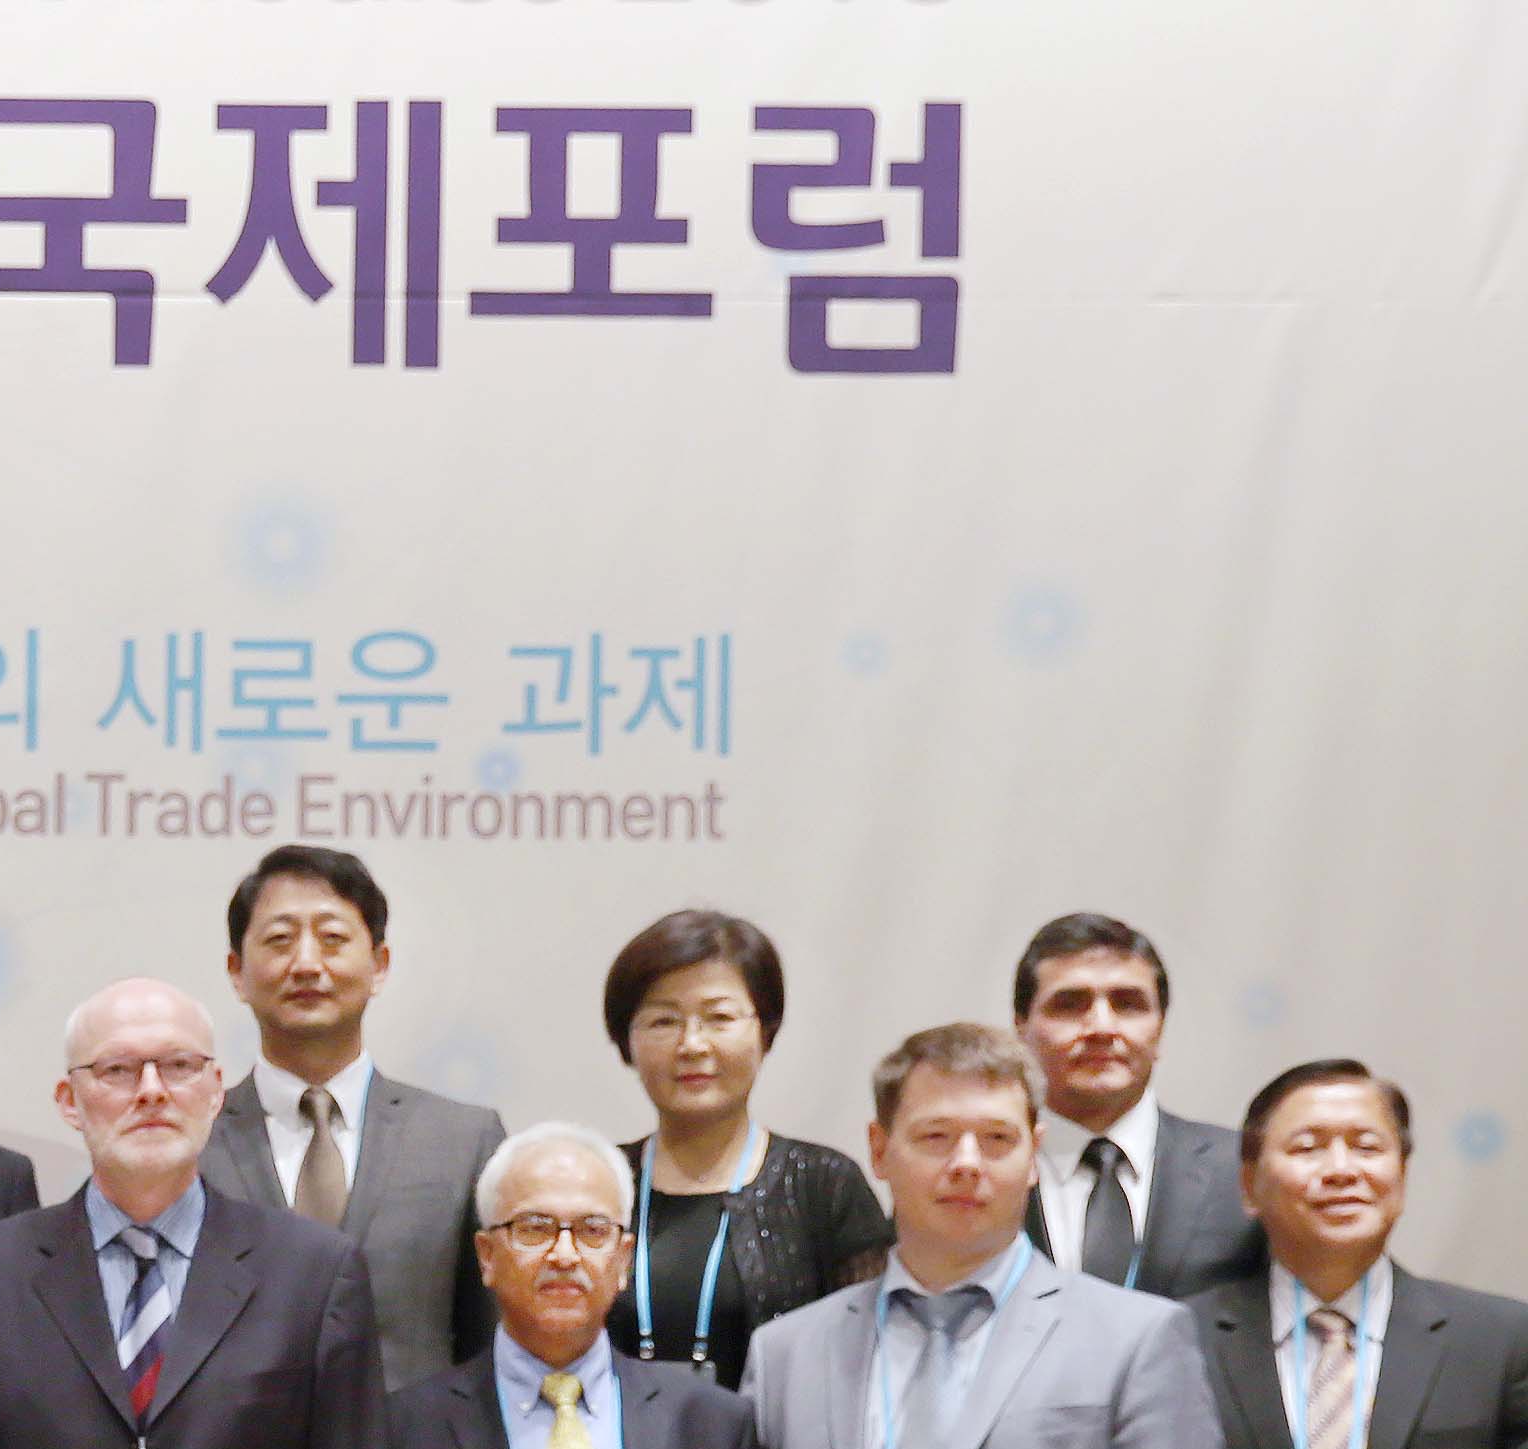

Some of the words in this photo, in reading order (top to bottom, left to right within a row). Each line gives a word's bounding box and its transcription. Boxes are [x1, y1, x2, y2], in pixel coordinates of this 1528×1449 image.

[99, 632, 450, 752] 새로운
[503, 636, 732, 755] 과제
[85, 773, 275, 838] Trade
[296, 773, 725, 842] Environment
